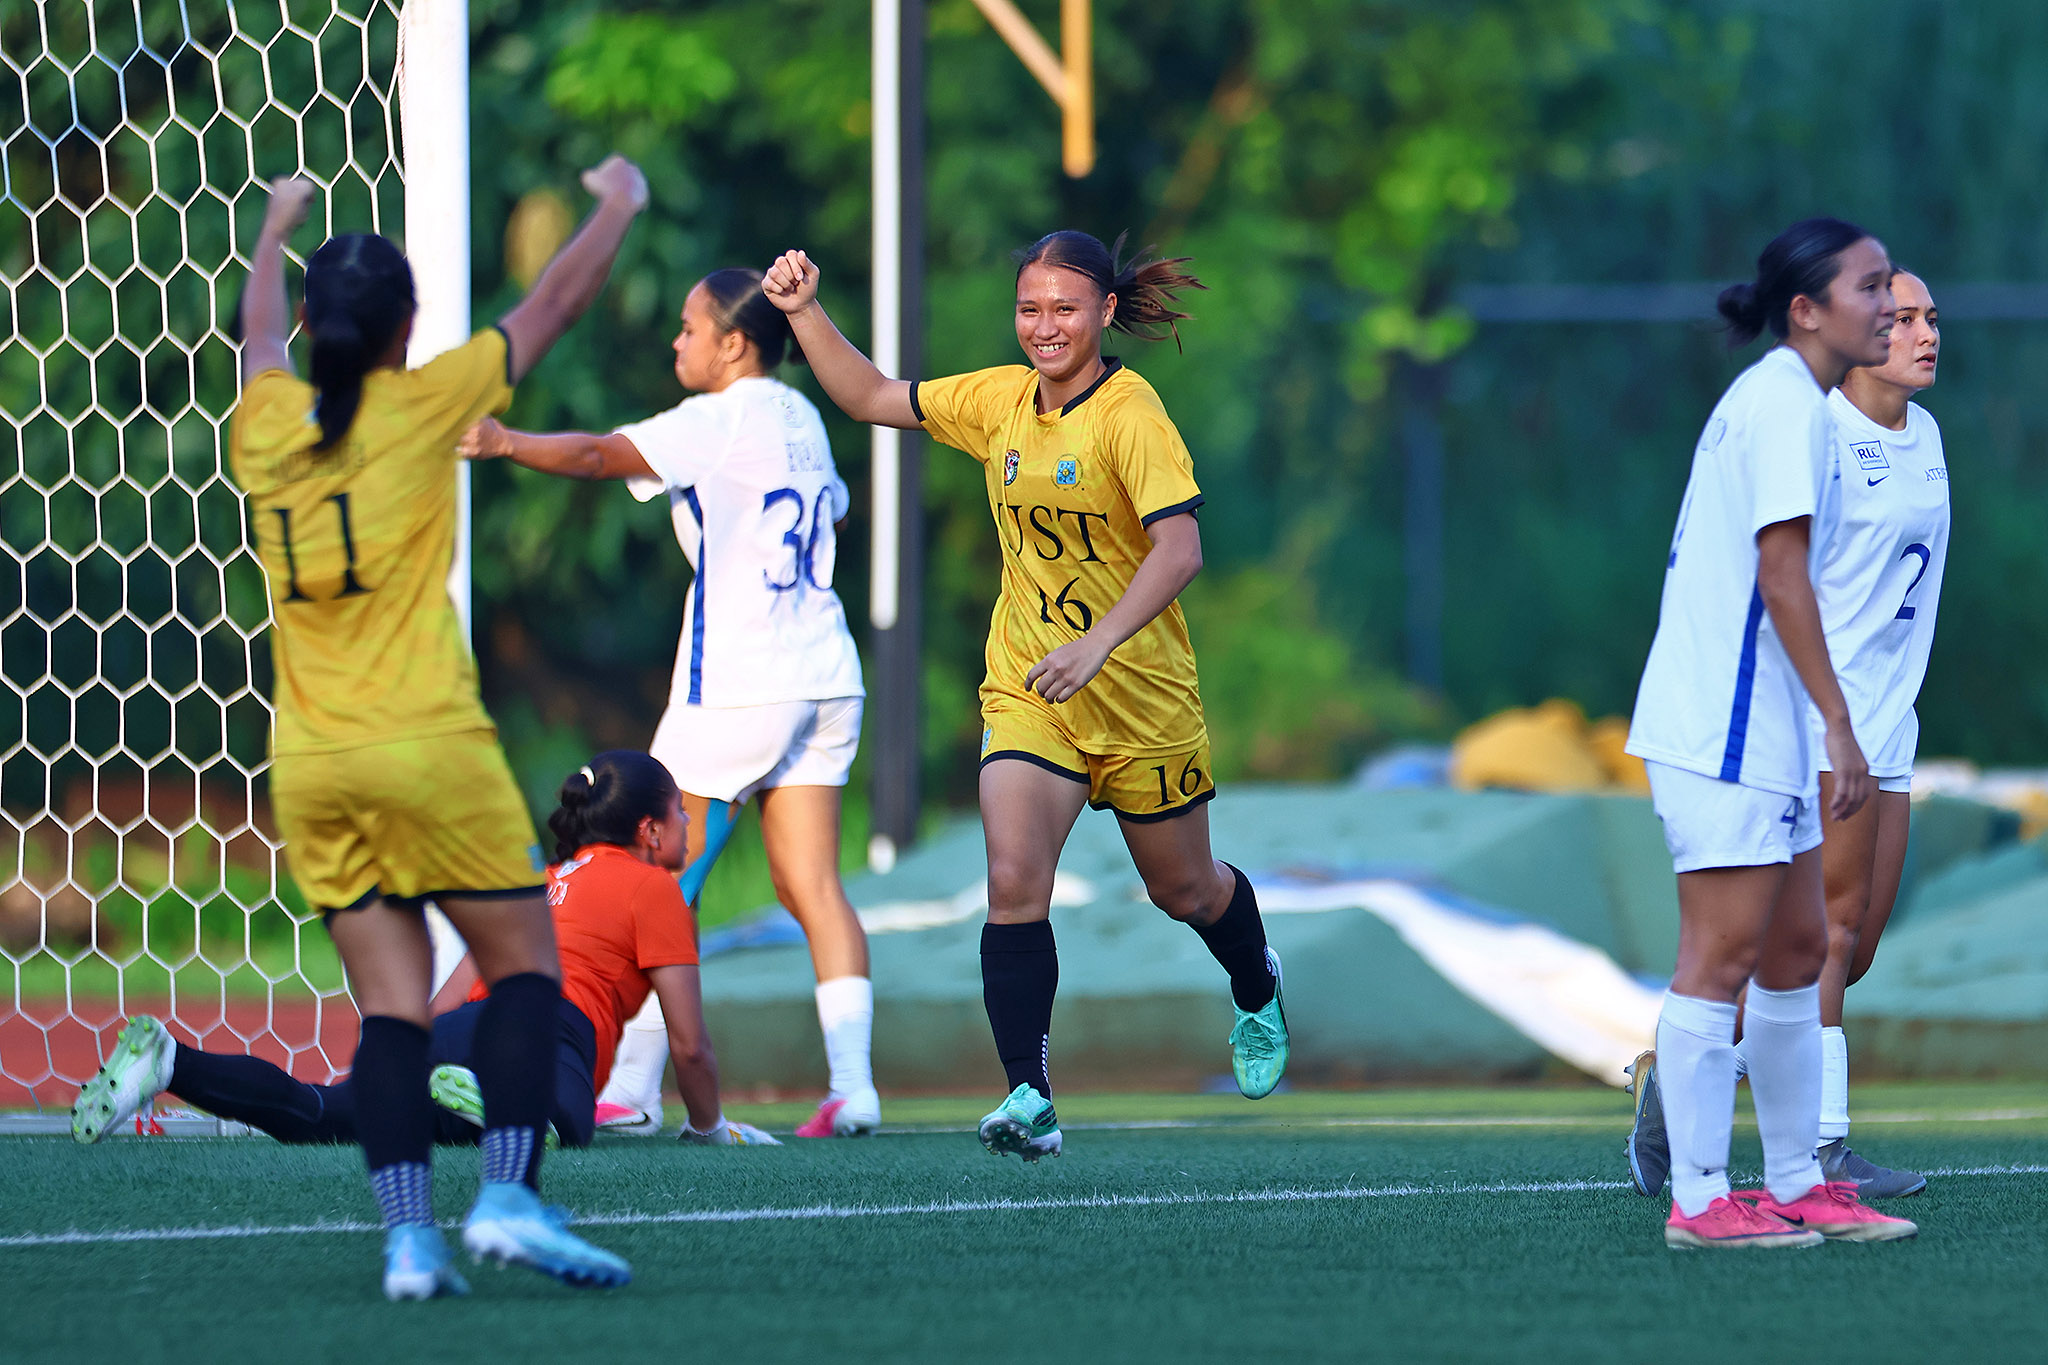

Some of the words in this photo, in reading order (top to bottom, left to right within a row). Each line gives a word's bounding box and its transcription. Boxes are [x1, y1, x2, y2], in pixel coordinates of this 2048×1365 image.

[1857, 447, 1880, 459] RLC
[270, 493, 378, 604] 11
[762, 486, 836, 591] 30
[997, 502, 1109, 565] UST
[1037, 577, 1093, 632] 16
[1894, 543, 1930, 620] 2
[1150, 750, 1202, 809] 16
